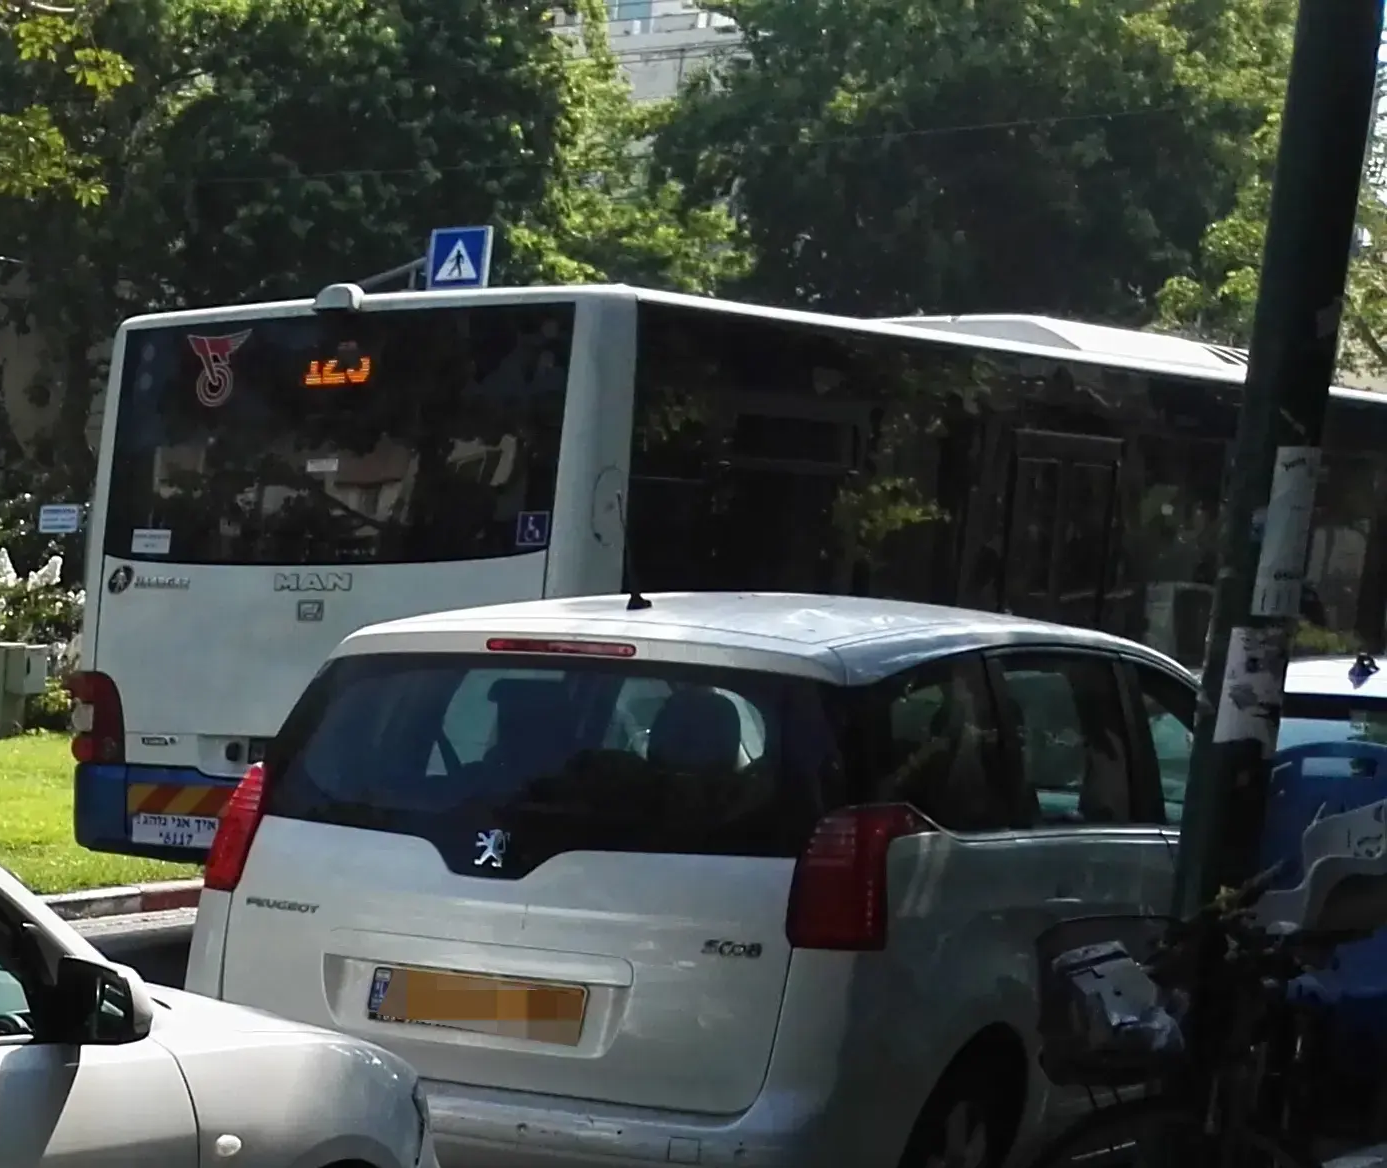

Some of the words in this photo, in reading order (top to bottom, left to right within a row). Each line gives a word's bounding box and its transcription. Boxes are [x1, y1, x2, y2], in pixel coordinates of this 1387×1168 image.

[274, 572, 353, 592] MAN
[171, 816, 191, 828] אני
[246, 896, 320, 914] PEUGEOT
